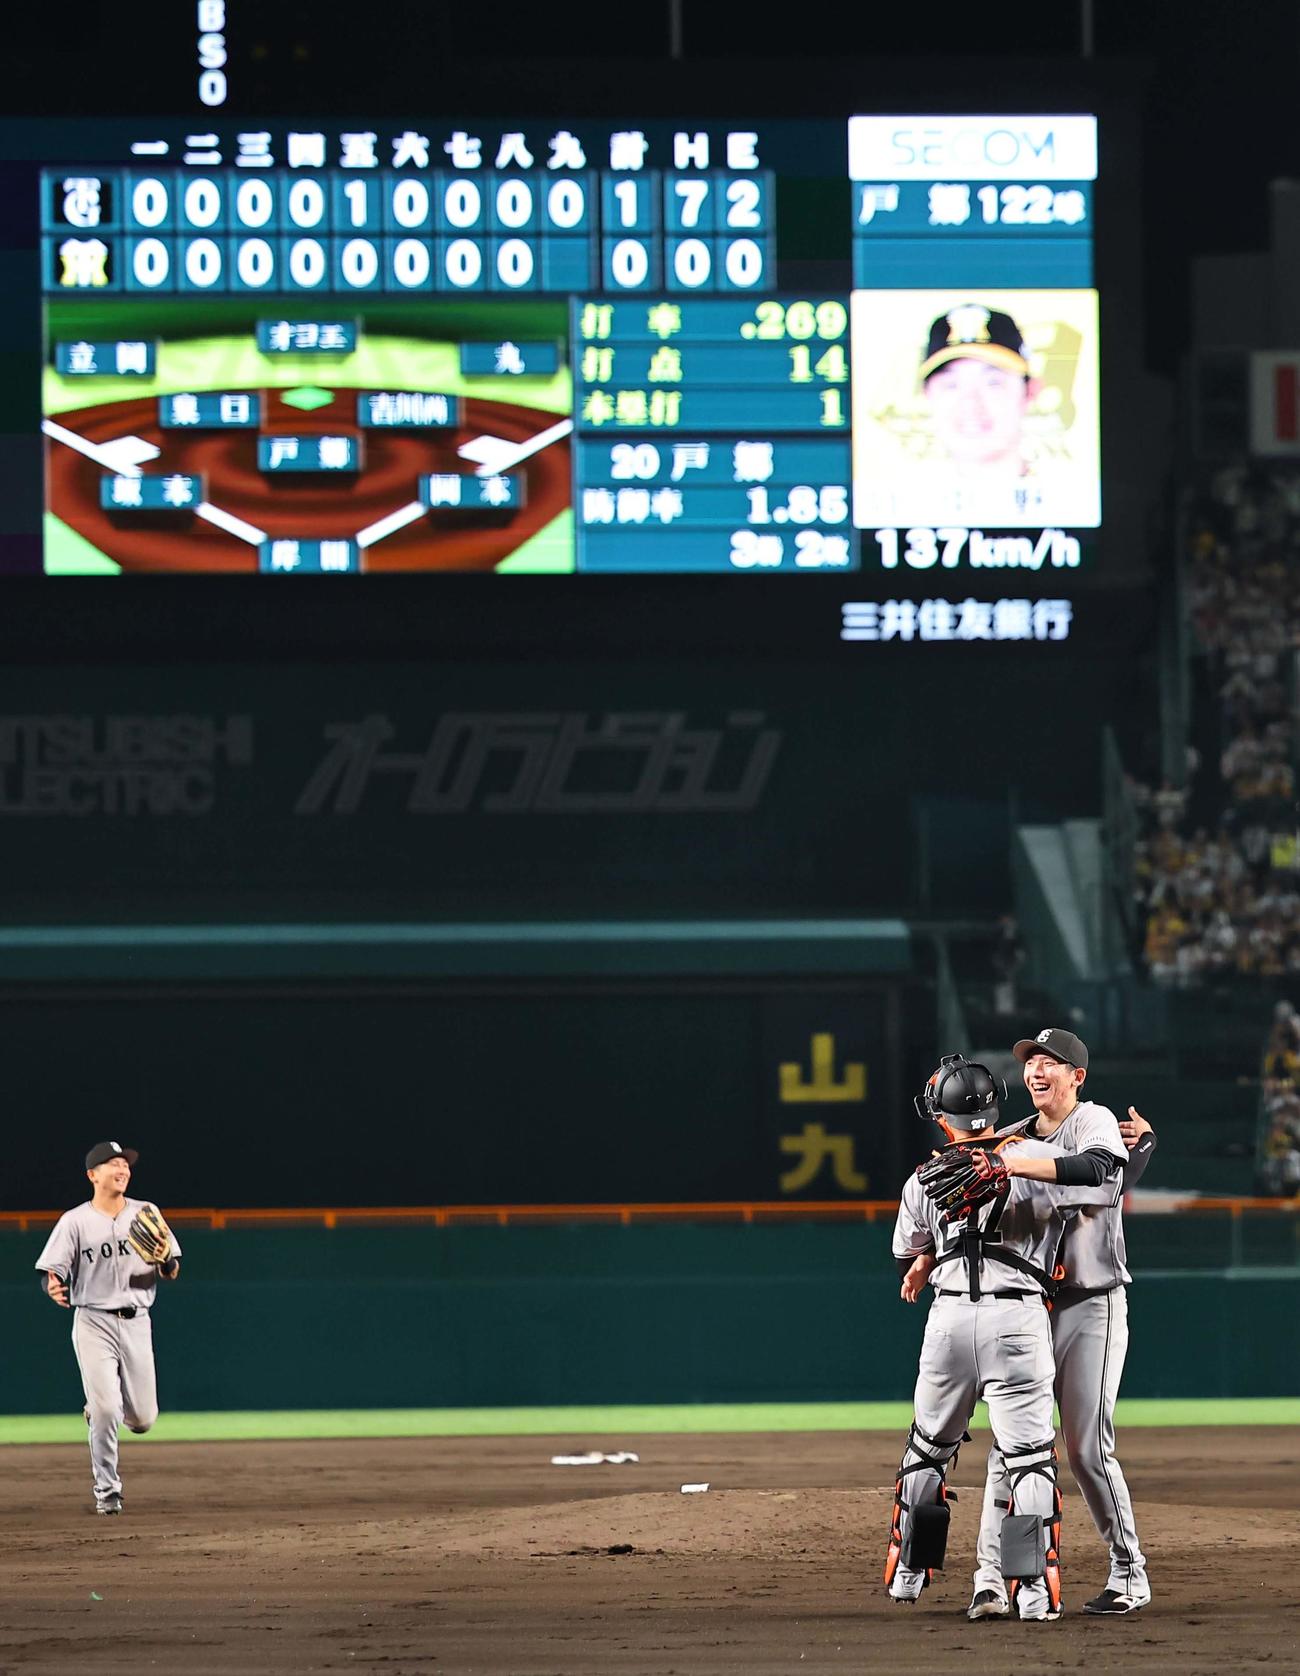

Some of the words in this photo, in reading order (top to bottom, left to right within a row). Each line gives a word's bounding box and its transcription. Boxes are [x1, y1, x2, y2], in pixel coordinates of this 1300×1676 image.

[132, 142, 168, 154] 一
[186, 135, 221, 164] 二
[237, 133, 273, 166] 三
[342, 133, 377, 167] 五
[394, 132, 428, 167] 六
[445, 132, 480, 168] 七
[496, 134, 533, 167] 八
[548, 132, 585, 169] 九
[674, 133, 708, 168] H
[727, 133, 758, 168] E
[892, 128, 1056, 166] SECOM
[133, 179, 167, 226] 0
[185, 179, 220, 227] 0
[238, 179, 272, 227] 0
[290, 179, 323, 227] 0
[345, 180, 366, 226] 1
[393, 180, 428, 227] 0
[445, 180, 480, 227] 0
[497, 180, 531, 227] 0
[548, 180, 583, 227] 0
[615, 181, 636, 226] 1
[676, 180, 707, 226] 7
[727, 180, 760, 227] 2
[134, 239, 168, 285] 0
[186, 239, 221, 286] 0
[238, 239, 273, 287] 0
[290, 239, 324, 286] 0
[342, 239, 377, 286] 0
[394, 239, 429, 286] 0
[446, 239, 481, 285] 0
[498, 239, 533, 285] 0
[613, 240, 647, 287] 0
[675, 239, 710, 286] 0
[726, 239, 761, 285] 0
[741, 302, 847, 339] .269
[789, 345, 847, 382] 14
[820, 389, 844, 426] 1
[611, 444, 659, 478] 20
[748, 486, 847, 523] 1.85
[875, 529, 1080, 570] 137km/h
[841, 600, 1072, 641] 三井住友銀行
[0, 714, 253, 765] ITSUBISHI
[778, 1033, 868, 1193] 山九
[971, 1118, 986, 1130] 27
[82, 1239, 130, 1263] TOK
